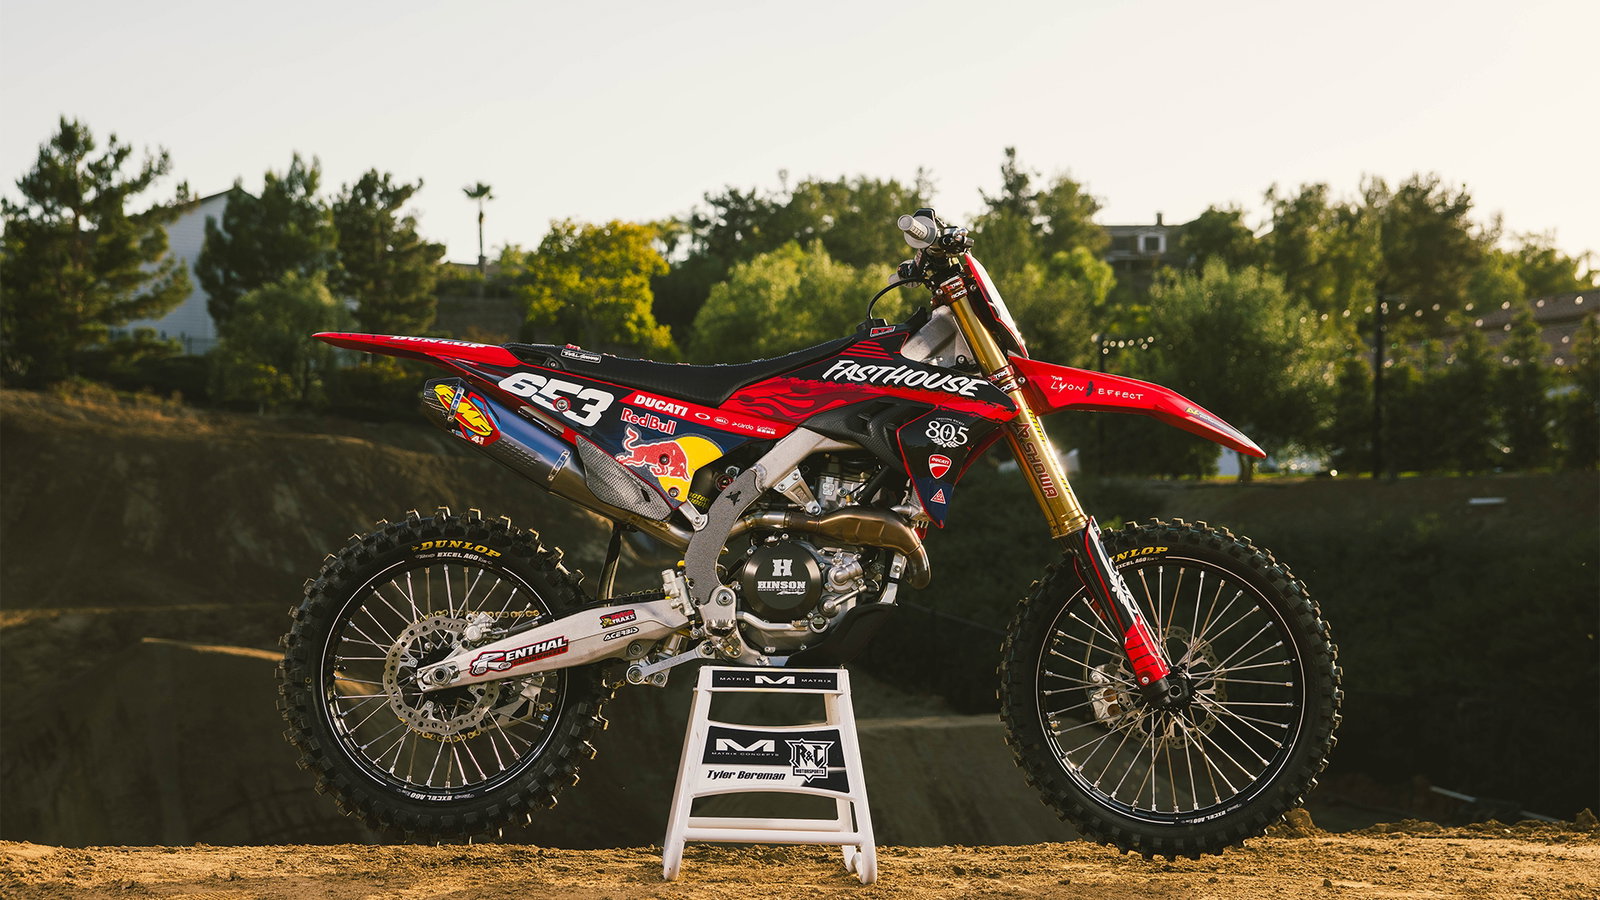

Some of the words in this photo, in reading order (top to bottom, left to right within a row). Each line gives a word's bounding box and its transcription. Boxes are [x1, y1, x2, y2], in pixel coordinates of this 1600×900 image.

[822, 360, 988, 397] FASTHOUSE
[434, 384, 493, 433] FMF
[498, 372, 615, 427] 653
[634, 395, 689, 417] DUCATI
[620, 407, 650, 427] Red
[648, 415, 677, 435] Bull
[925, 420, 969, 445] 805
[1023, 441, 1059, 499] SHOWA
[420, 540, 502, 558] DUNLOP
[1109, 546, 1168, 562] NLOP
[772, 559, 793, 576] H
[757, 581, 806, 589] HINSON
[471, 637, 567, 675] RENTHAL
[707, 769, 736, 779] Tyler
[737, 771, 786, 780] Bereman
